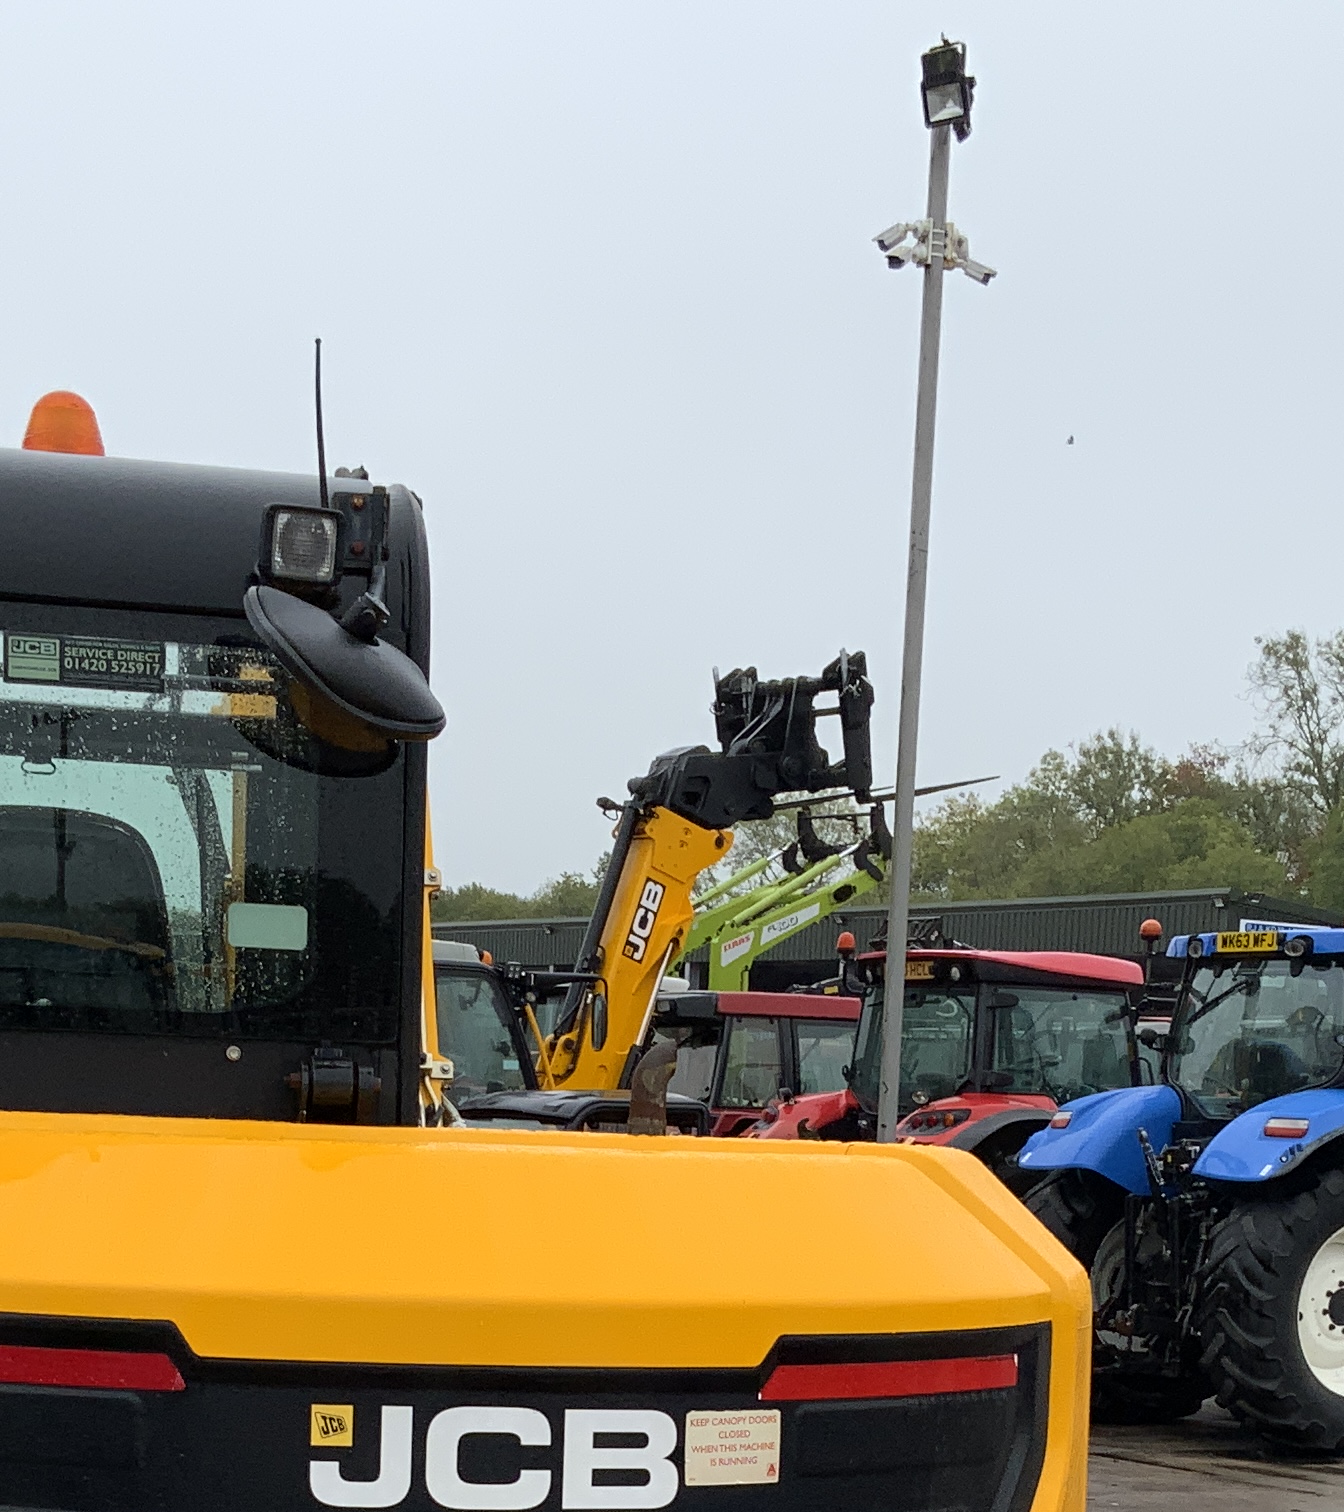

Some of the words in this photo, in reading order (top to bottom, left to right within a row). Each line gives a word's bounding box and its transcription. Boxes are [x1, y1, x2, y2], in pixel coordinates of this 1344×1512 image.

[12, 640, 56, 655] JCB
[64, 646, 115, 660] SERVICE
[117, 650, 161, 663] DIRECT
[64, 657, 107, 672] 01420
[111, 660, 161, 676] 525917
[626, 880, 664, 962] JCB
[723, 934, 751, 953] CLAAS
[320, 1415, 345, 1435] JCB
[690, 1418, 710, 1427] KEEP
[711, 1416, 747, 1426] CANOPY
[748, 1415, 777, 1424] DOORS
[718, 1430, 751, 1439] CLOSED
[691, 1445, 718, 1454] WHEN
[719, 1443, 738, 1453] THIS
[739, 1442, 775, 1451] MACHINE
[309, 1405, 679, 1511] JCB
[710, 1458, 717, 1467] IS
[718, 1456, 758, 1466] RUNNING
